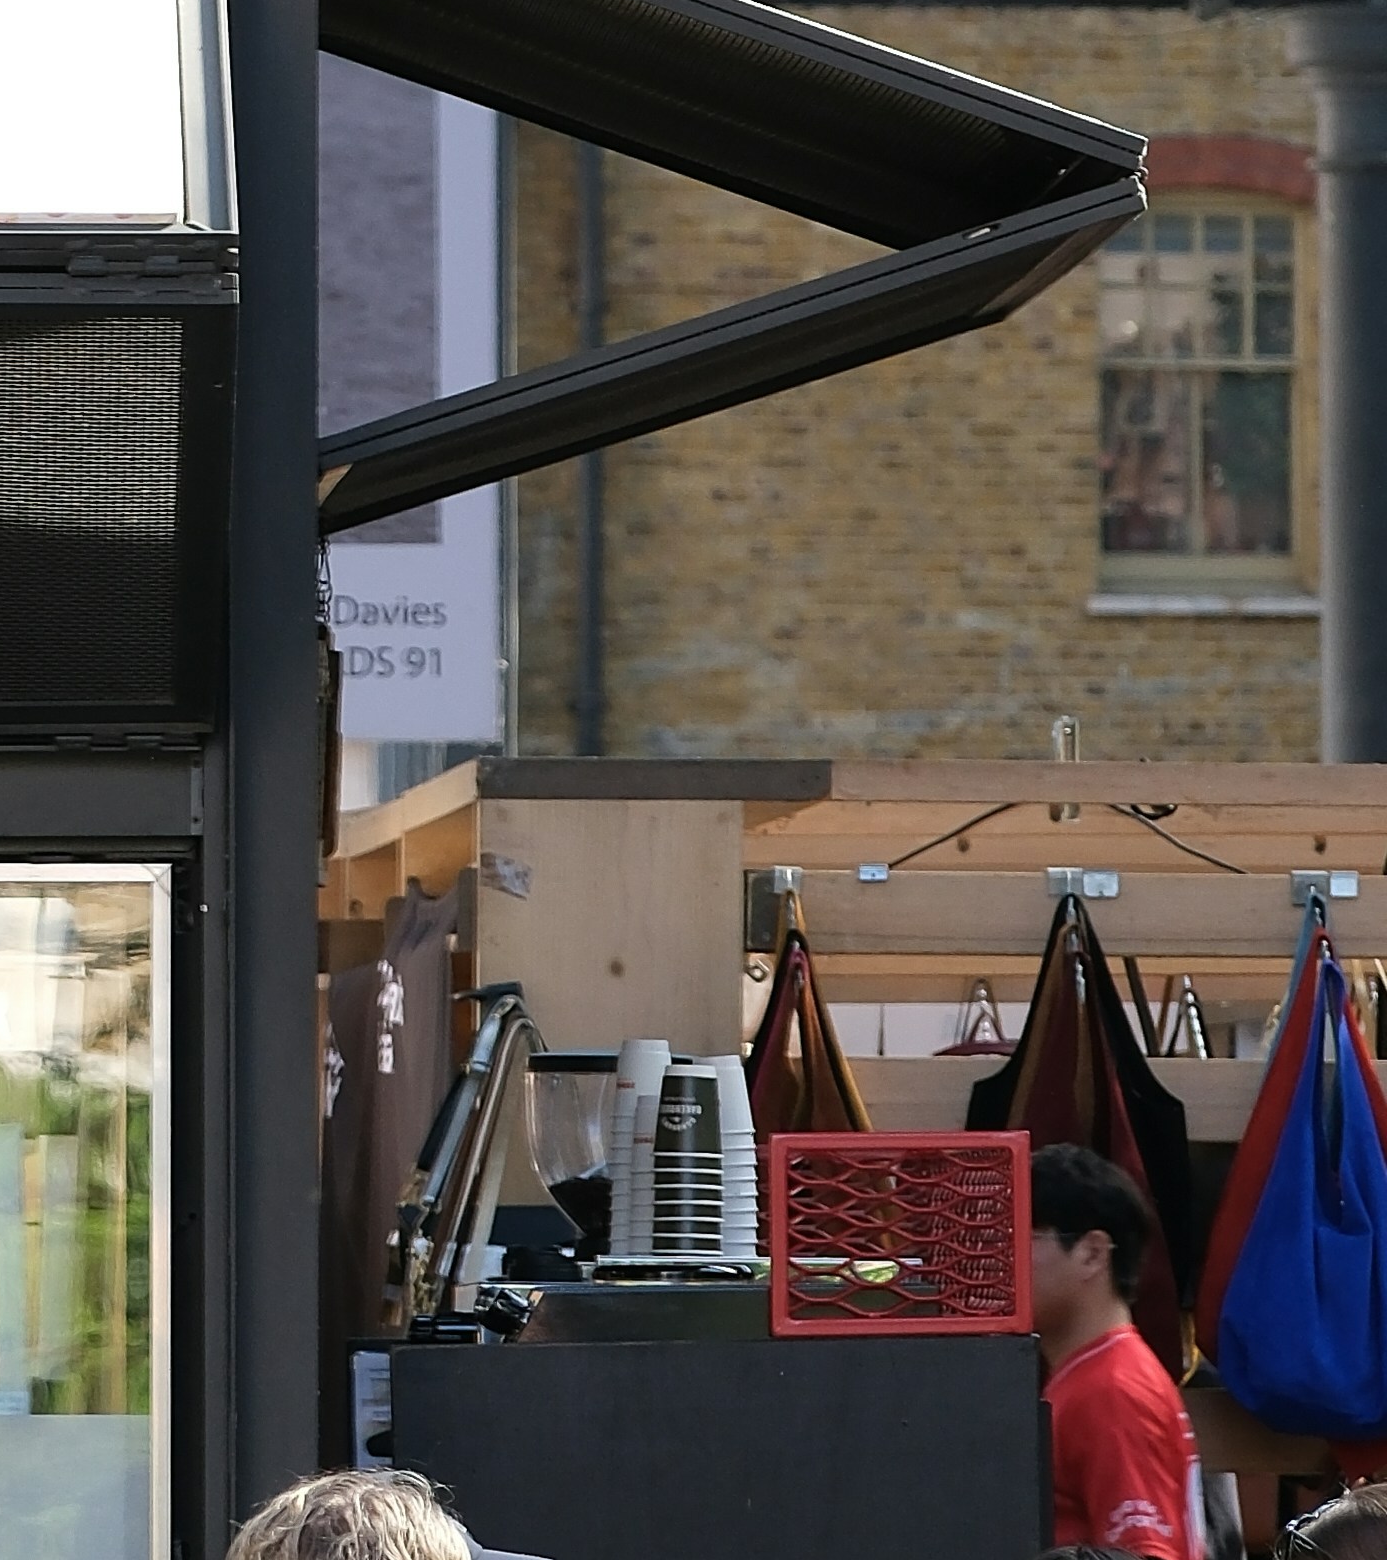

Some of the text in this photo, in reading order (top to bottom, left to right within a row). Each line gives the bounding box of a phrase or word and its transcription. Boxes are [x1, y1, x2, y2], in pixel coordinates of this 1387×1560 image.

[333, 594, 448, 626] Davies
[342, 645, 443, 679] DS 91
